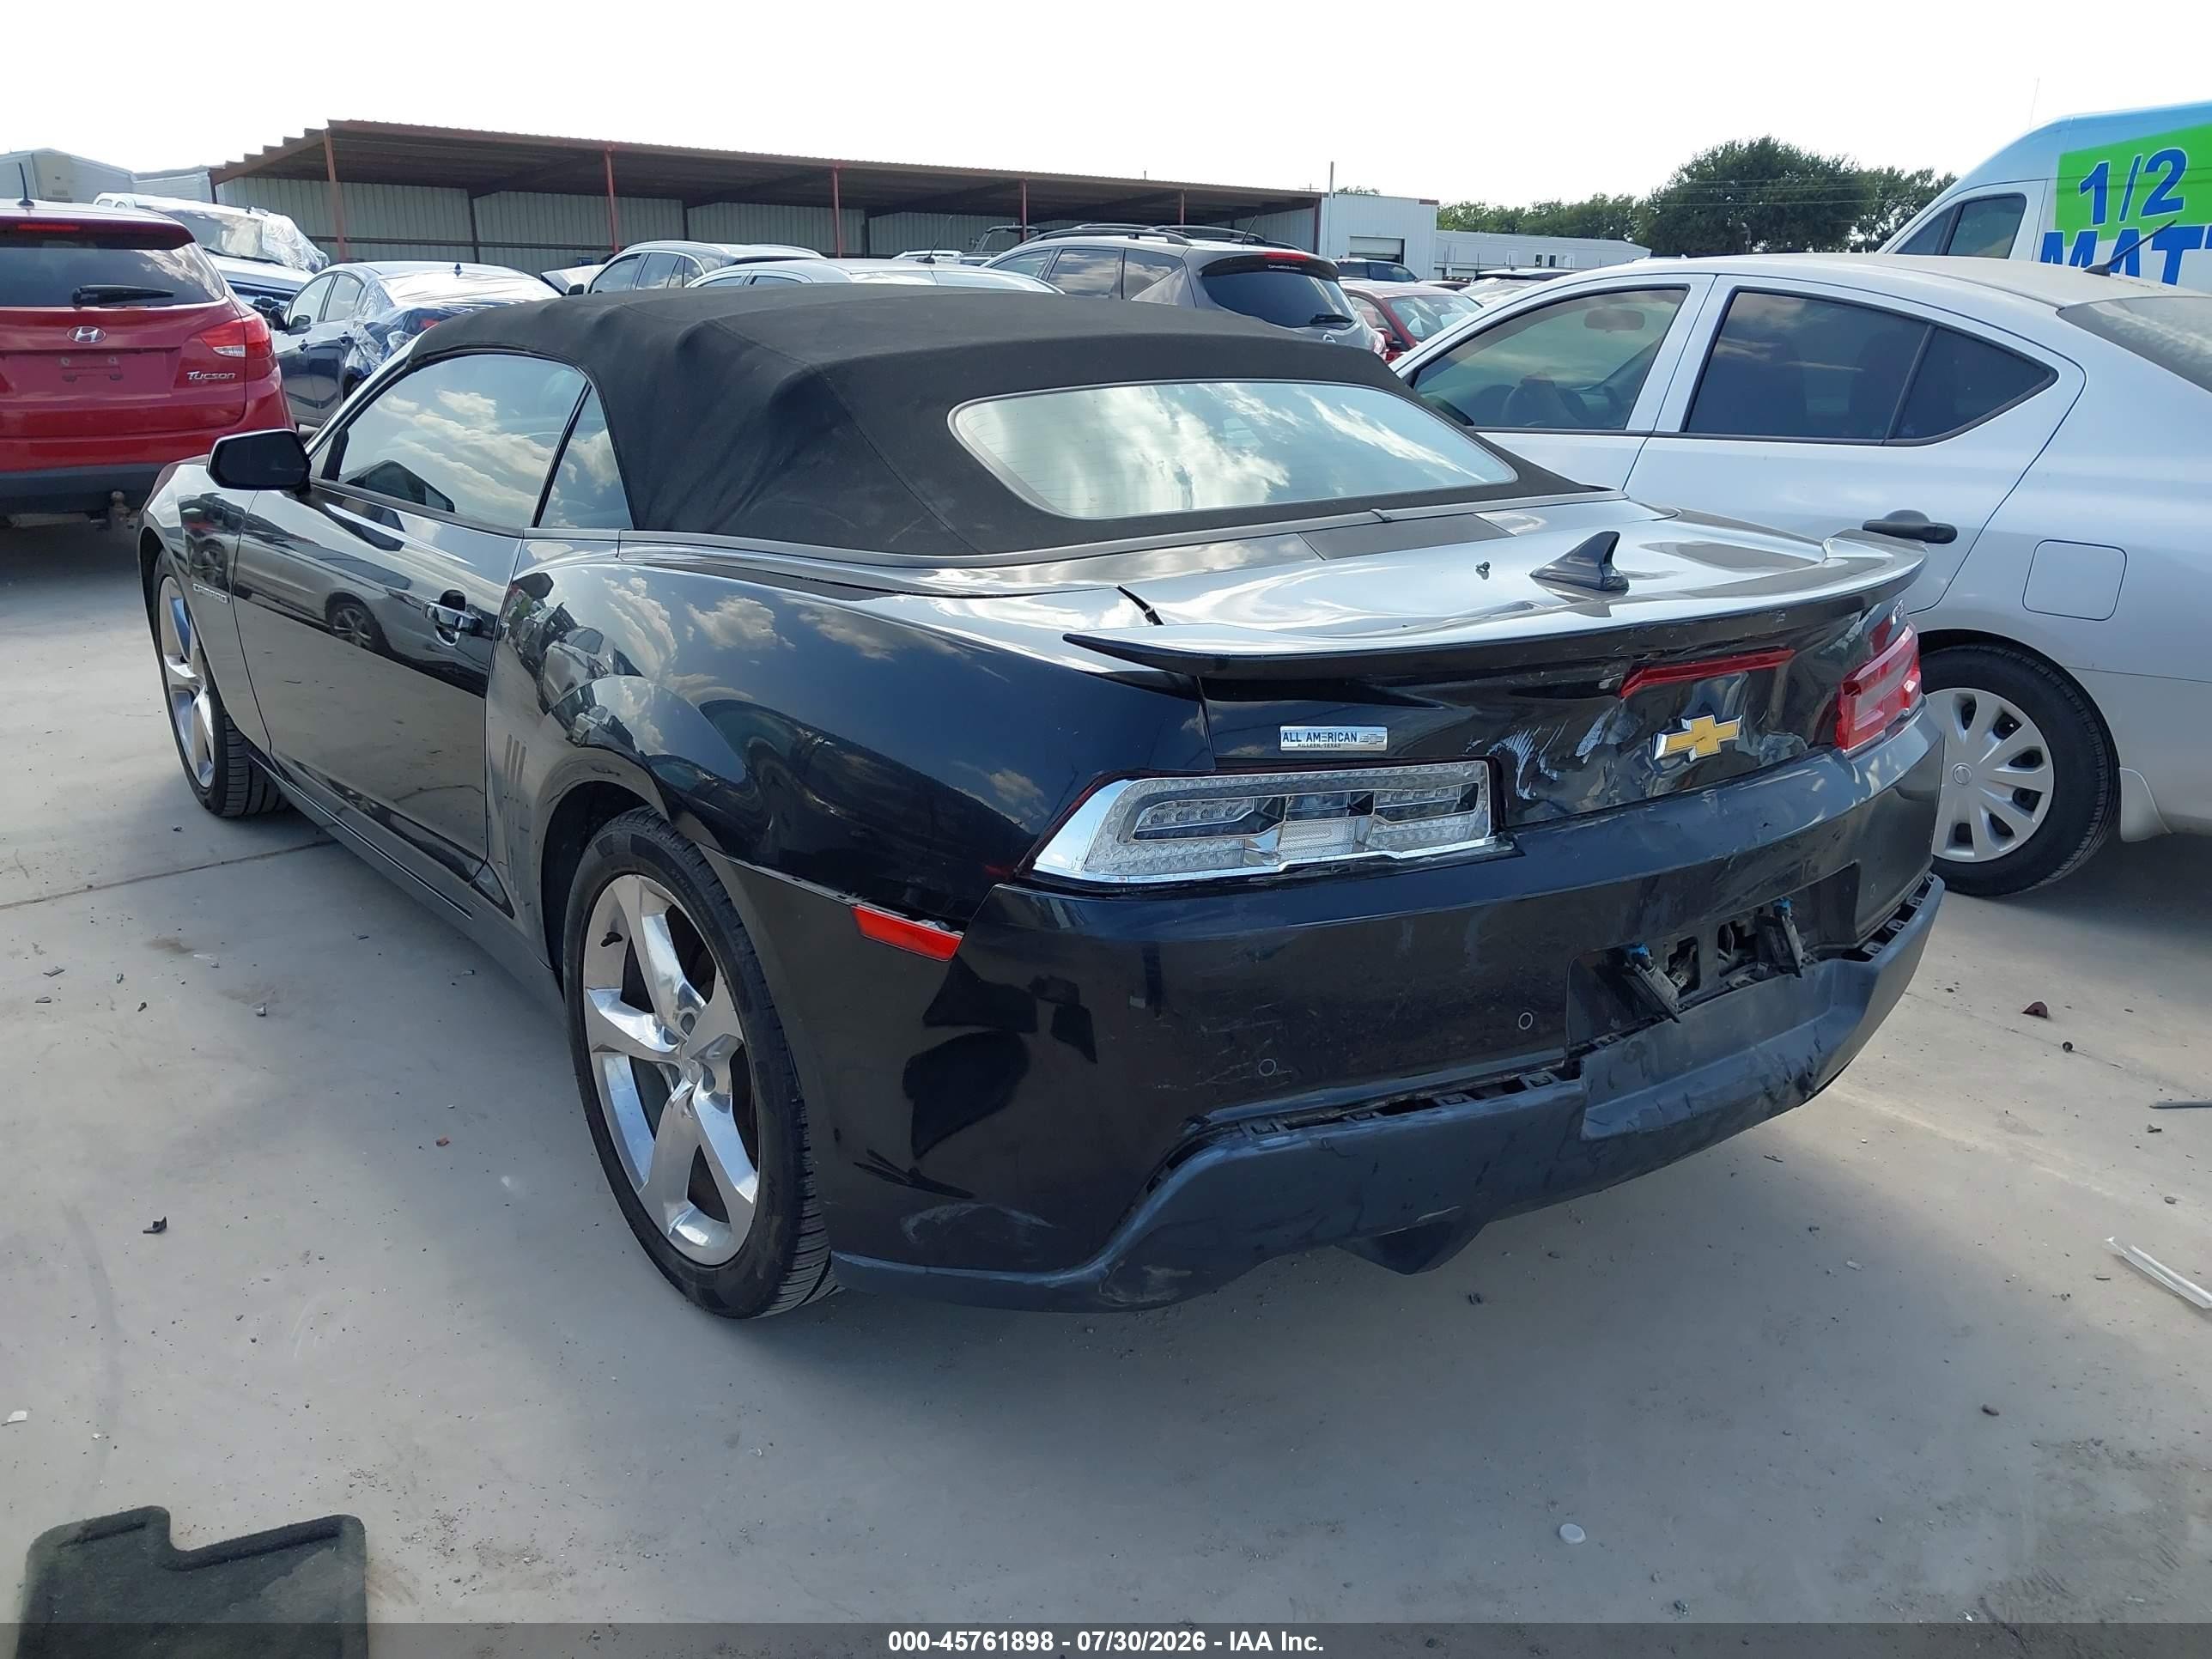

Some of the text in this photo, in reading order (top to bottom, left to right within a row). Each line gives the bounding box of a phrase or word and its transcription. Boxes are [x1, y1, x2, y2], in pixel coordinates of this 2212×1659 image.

[2079, 147, 2188, 225] 1/2
[187, 371, 236, 380] Tucson
[1282, 732, 1358, 743] ALL AMERICAN
